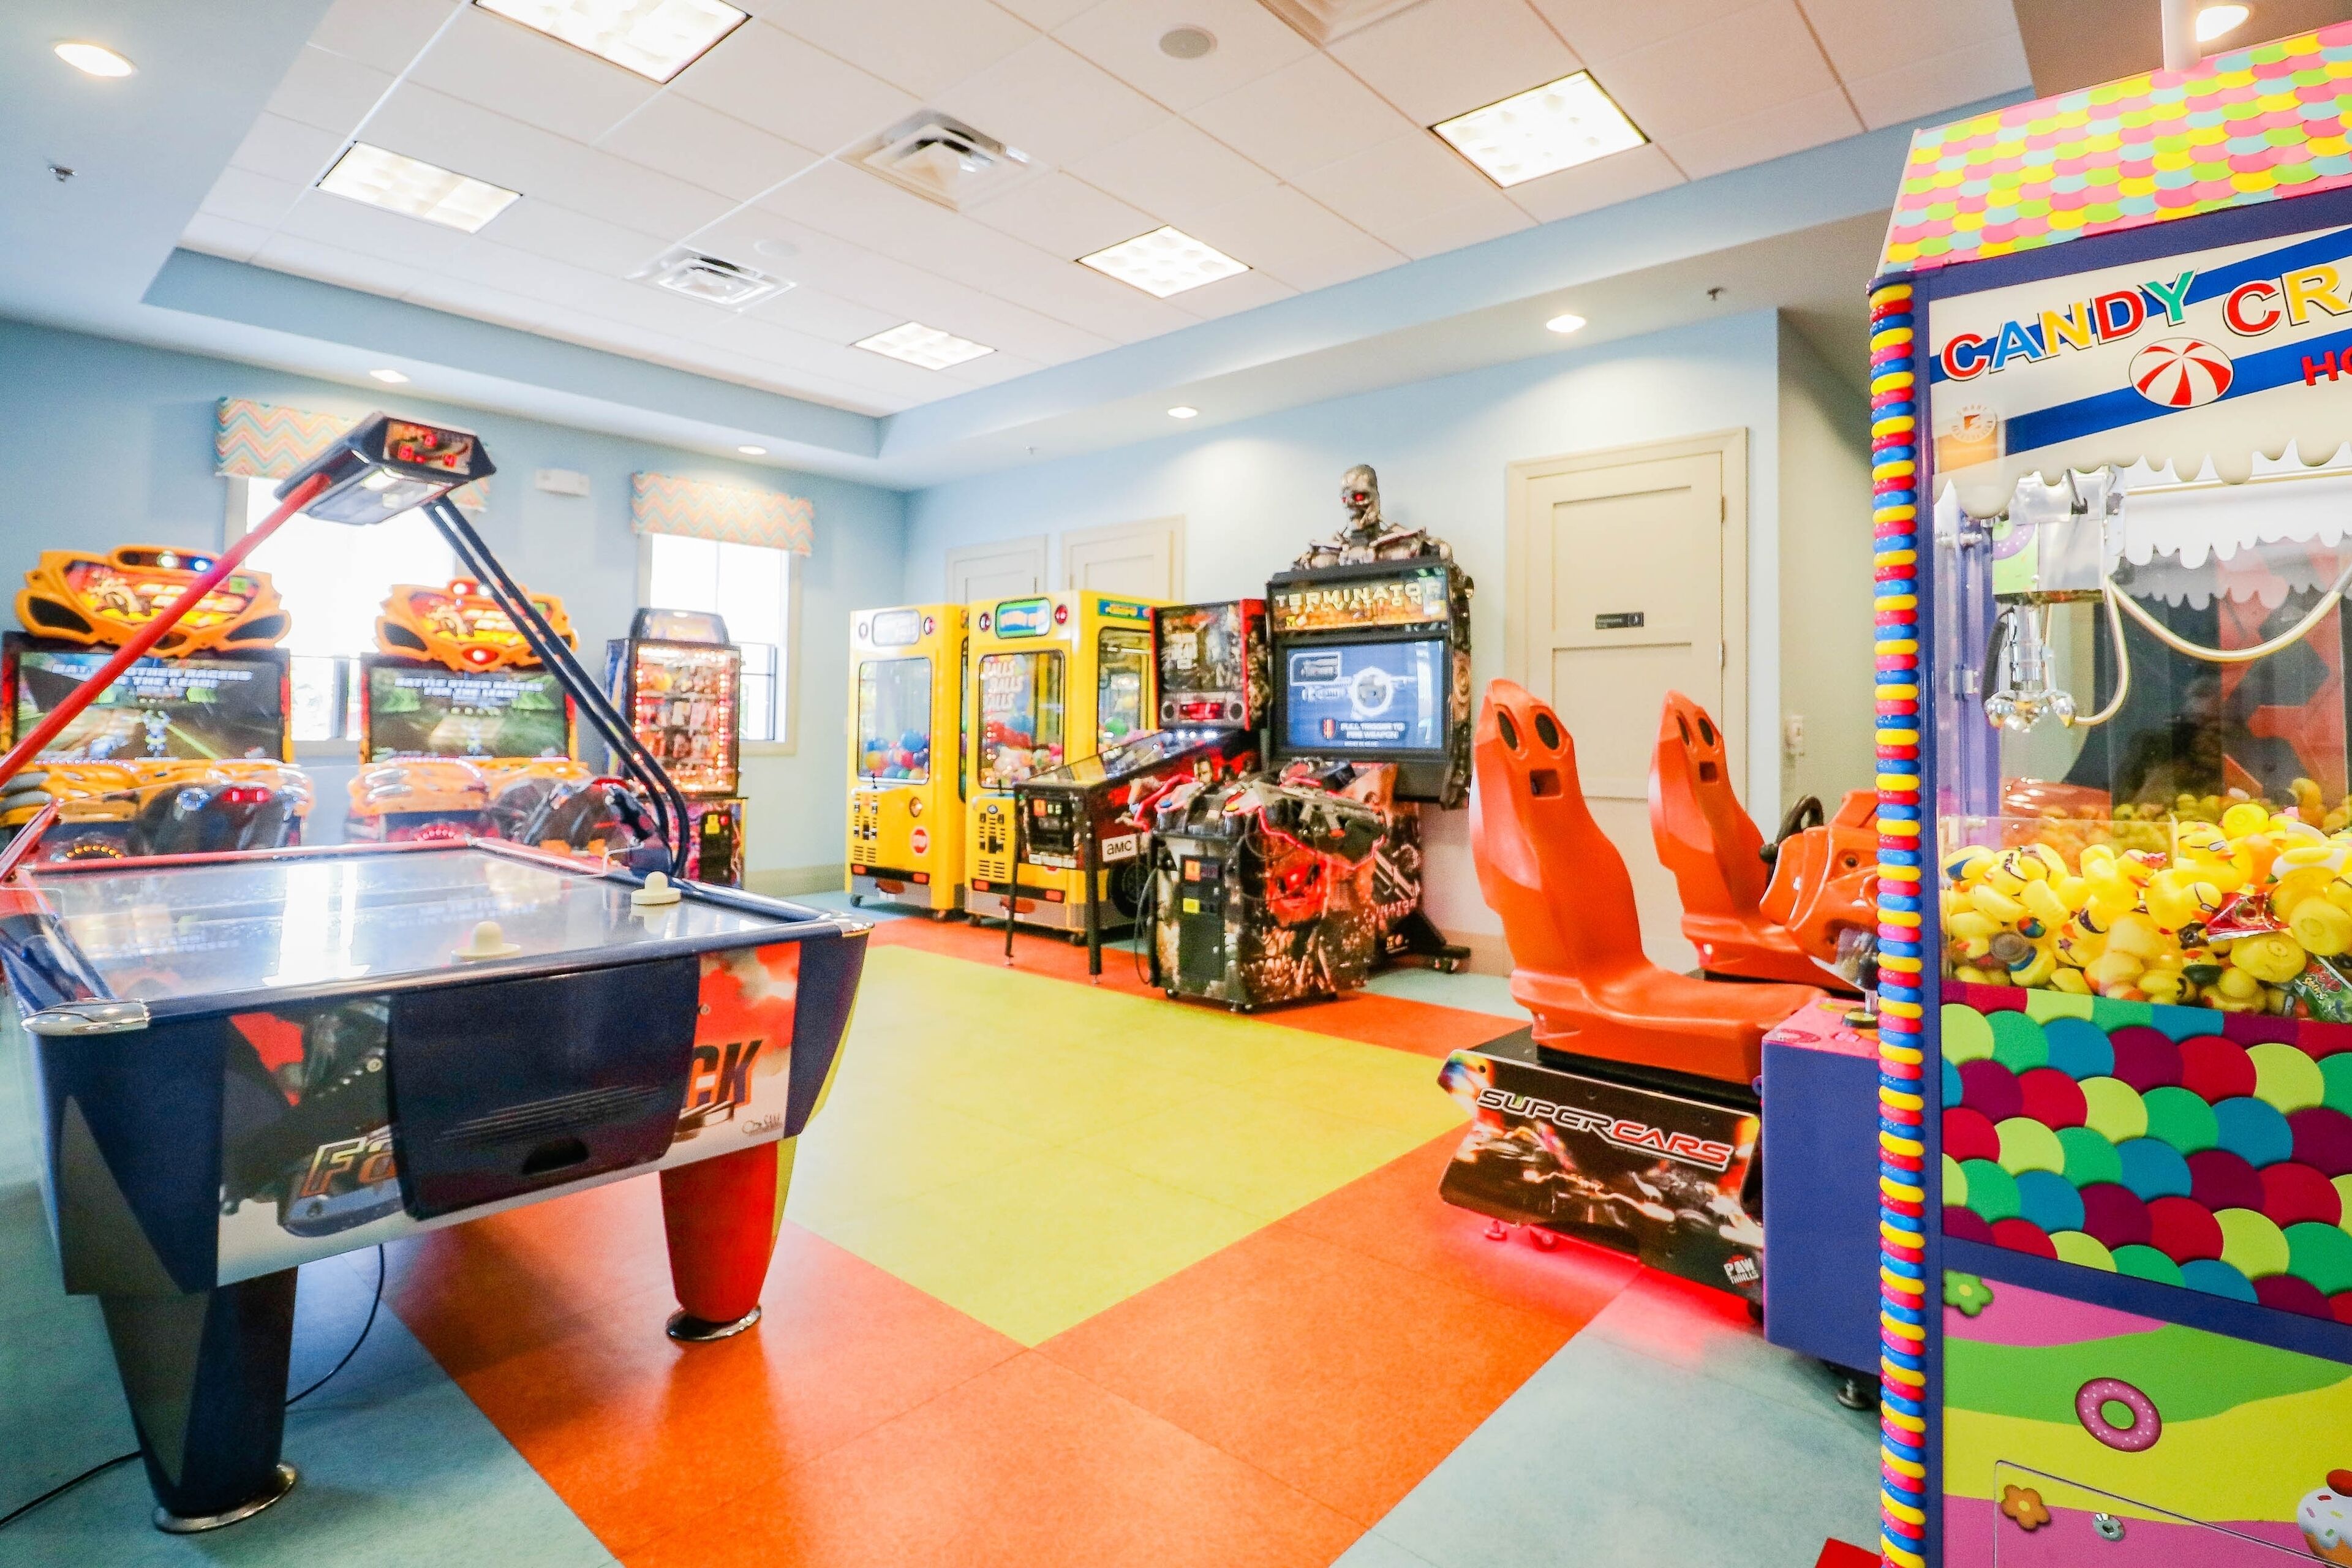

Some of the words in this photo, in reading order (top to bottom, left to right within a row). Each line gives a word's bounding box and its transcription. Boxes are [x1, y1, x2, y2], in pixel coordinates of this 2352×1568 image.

[1942, 270, 2196, 380] CANDY
[2223, 265, 2352, 336] CR
[1275, 581, 1441, 608] TERMINATOR
[1477, 1088, 1733, 1169] SUPERCARS
